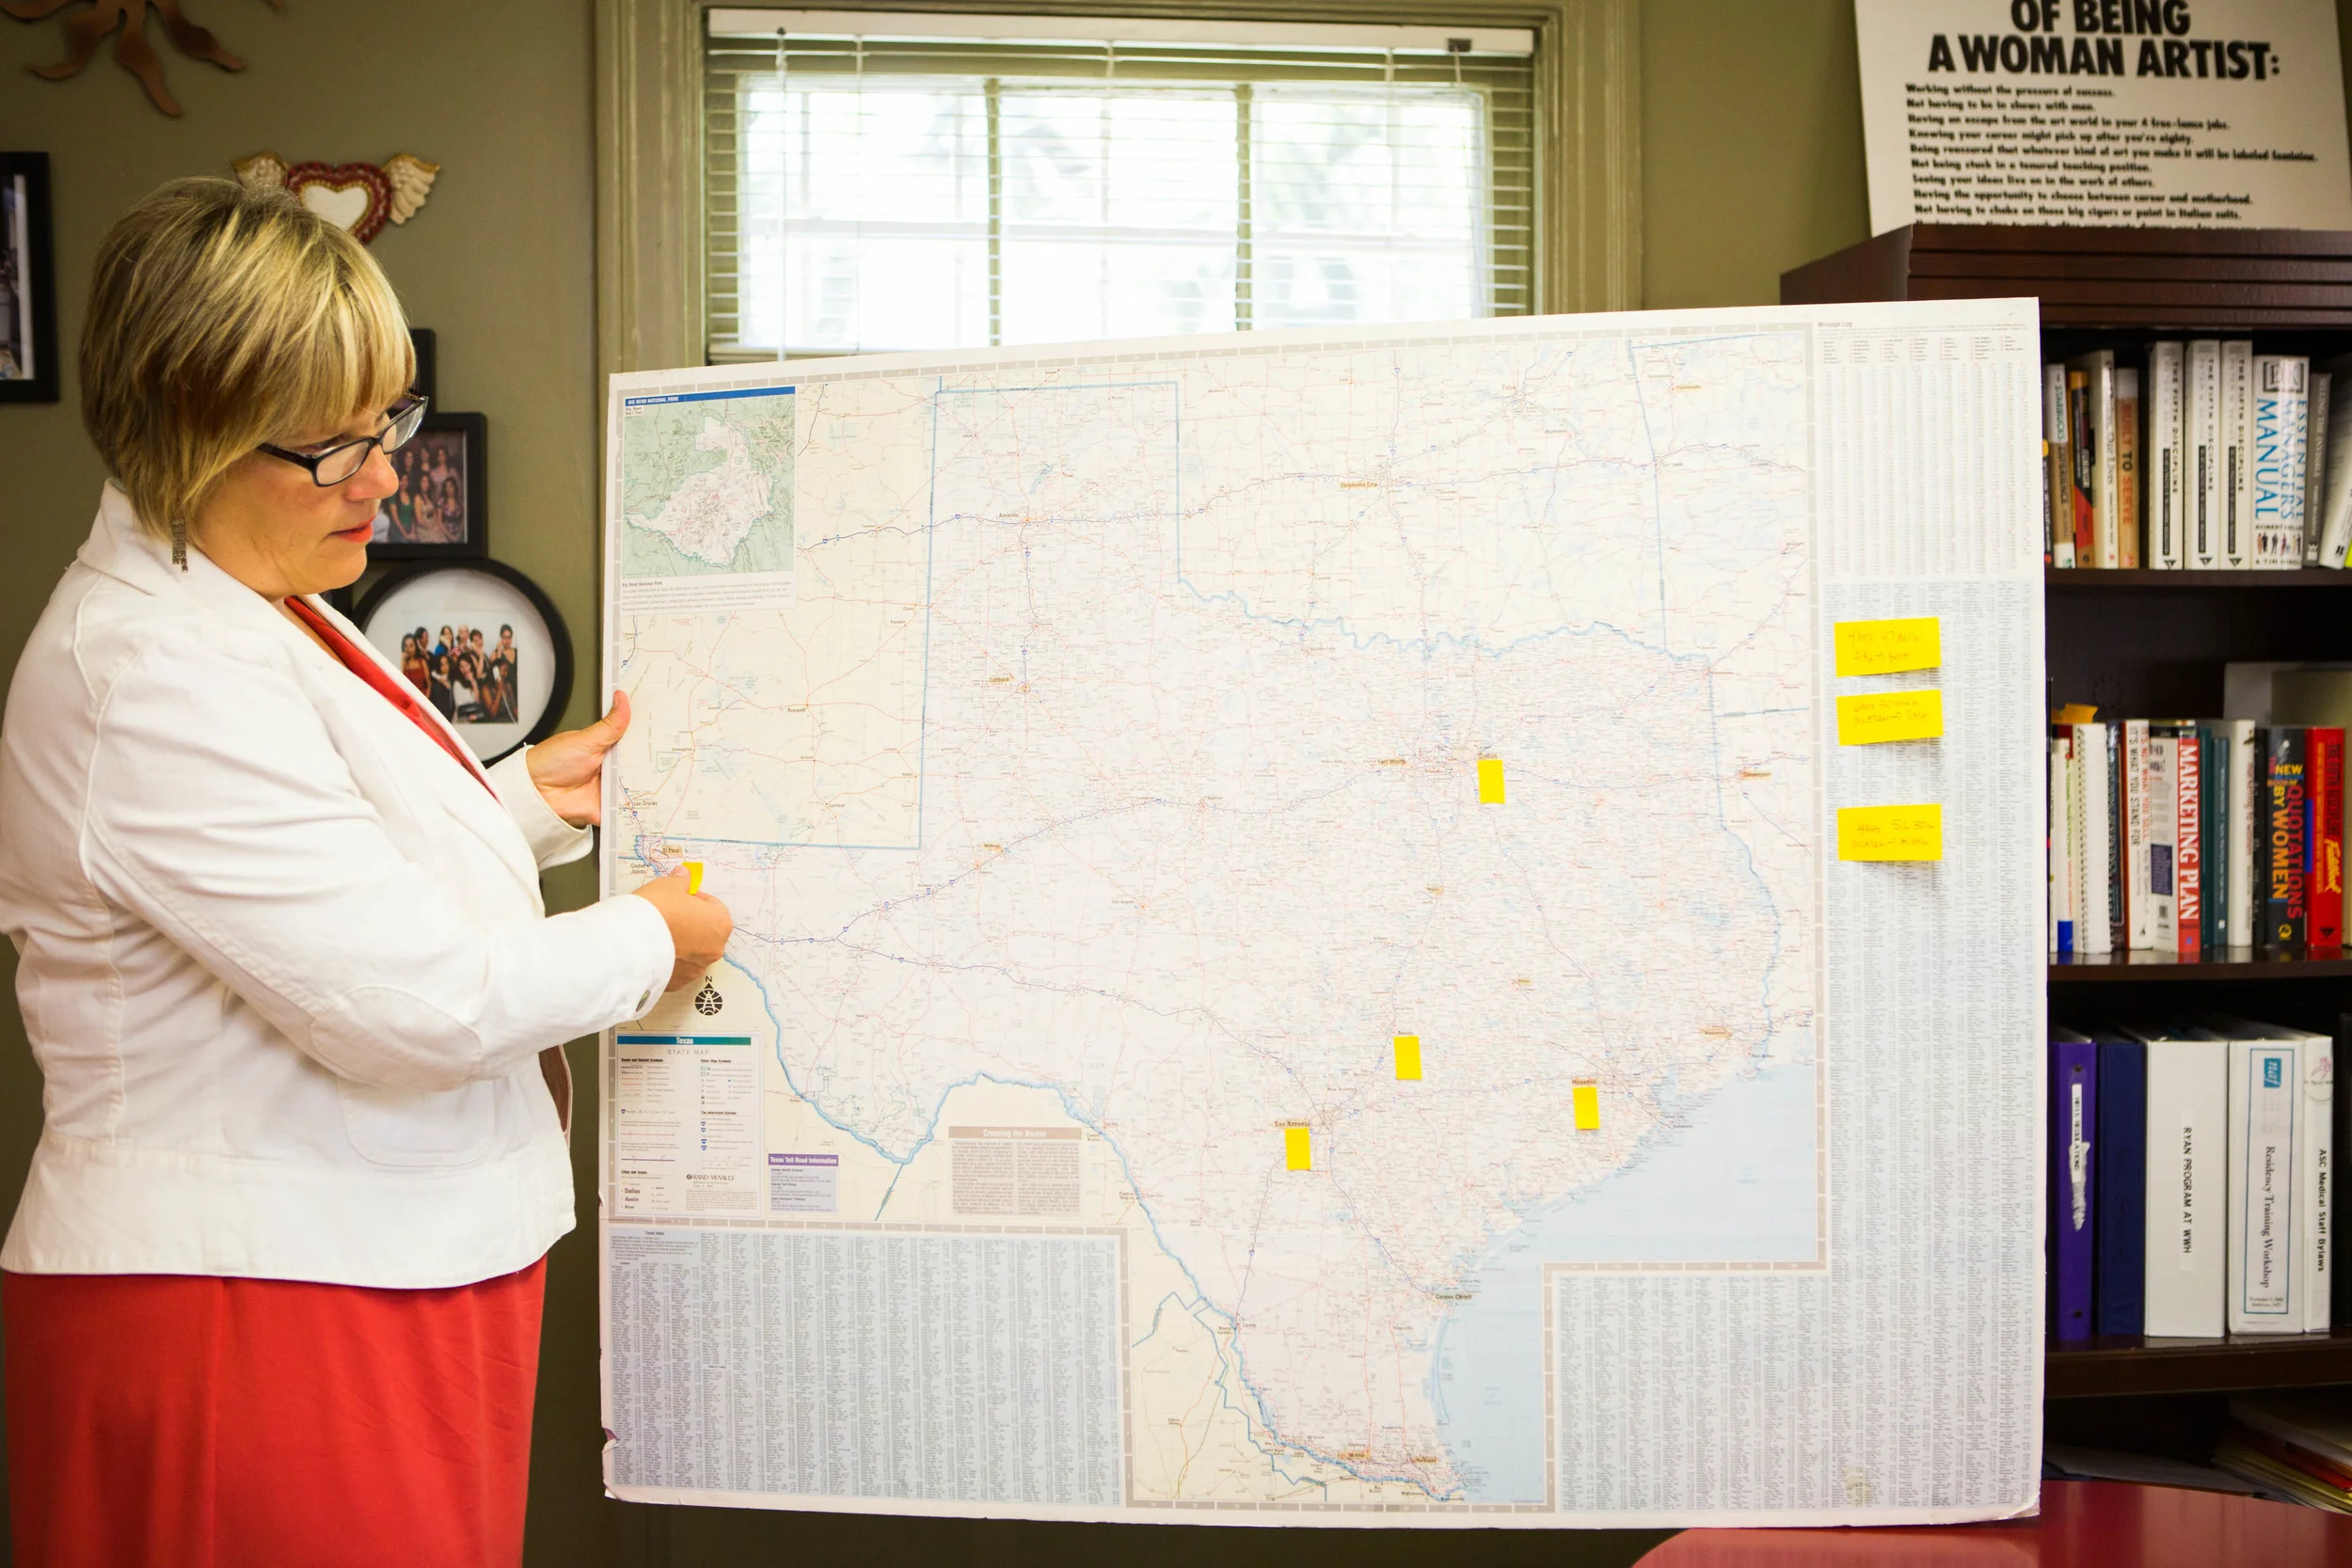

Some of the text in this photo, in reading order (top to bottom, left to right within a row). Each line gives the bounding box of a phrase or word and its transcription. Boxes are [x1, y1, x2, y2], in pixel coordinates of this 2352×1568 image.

[1929, 35, 2280, 80] A WOMAN ARTIST:
[2011, 0, 2190, 36] OF BEING
[2055, 386, 2068, 504] STARBUCKS EXPERIENCE
[2122, 404, 2134, 525] BUILT TO SERVE
[2255, 399, 2279, 519] MANUAL
[2280, 399, 2296, 519] MANAGER'S
[2296, 399, 2307, 519] ESSENTIAL
[2316, 418, 2325, 433] THE
[2130, 749, 2139, 772] WHAT
[2131, 777, 2139, 794] YOU
[2131, 798, 2140, 827] STAND
[2275, 764, 2302, 775] NEW
[2131, 830, 2140, 847] FOR
[2180, 745, 2199, 920] MARKETING PLAN
[2272, 785, 2288, 899] BY WOMEN
[2286, 784, 2303, 919] QUOTATIONS
[983, 1129, 1011, 1138] Crossing
[2183, 1127, 2192, 1254] RYAN PROGRAM AT WWH
[2261, 1146, 2276, 1289] Residency Training Workshop
[2317, 1148, 2327, 1273] ASC Medical Staff Bylaws
